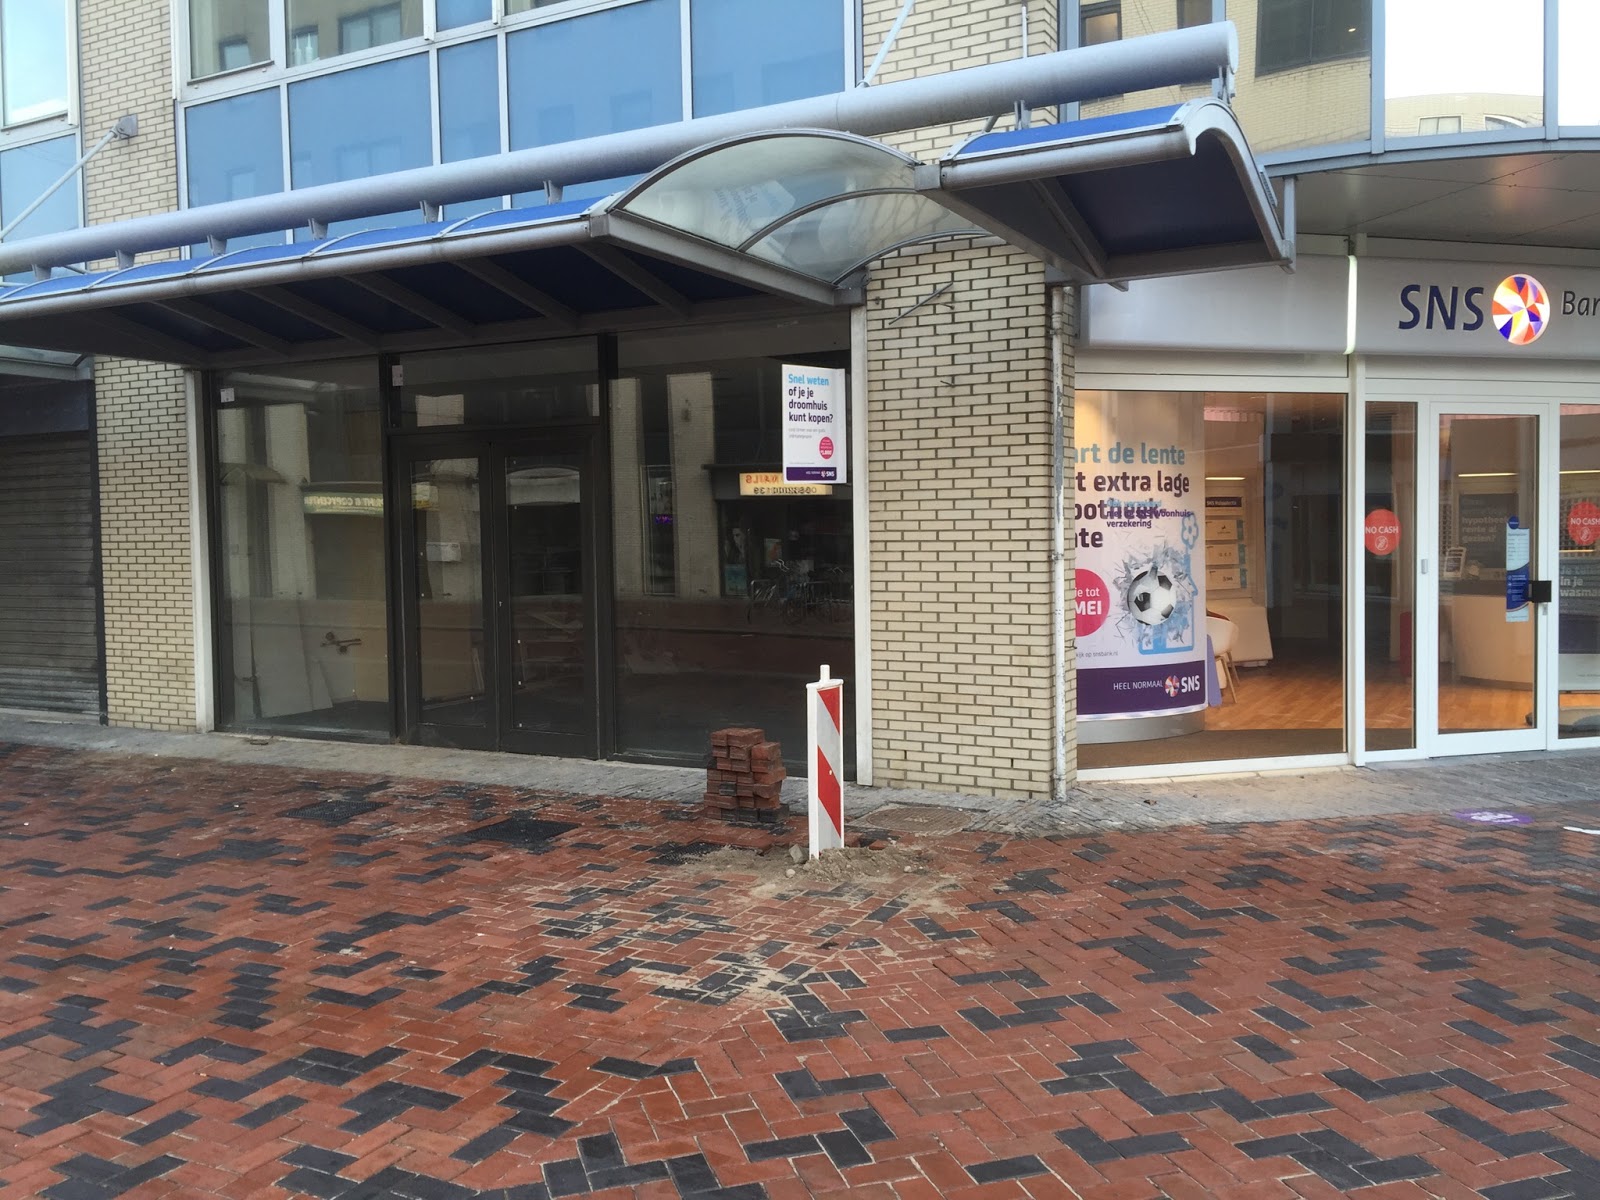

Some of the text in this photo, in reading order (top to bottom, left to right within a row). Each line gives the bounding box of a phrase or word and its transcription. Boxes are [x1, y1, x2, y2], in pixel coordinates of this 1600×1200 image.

[1398, 284, 1484, 331] SNS
[788, 373, 829, 386] Snel weten
[788, 386, 814, 400] of je je
[788, 399, 828, 411] droomhuis
[788, 411, 834, 425] kunt kopen?
[1075, 442, 1186, 466] rt de lente
[1093, 471, 1152, 492] extra
[1157, 470, 1190, 498] lage
[1106, 520, 1152, 529] verzekering
[1570, 517, 1600, 525] NO CASH
[1365, 525, 1399, 534] NO CASH
[1560, 576, 1571, 586] in
[1086, 587, 1100, 597] tot
[1075, 600, 1102, 616] MEI
[1113, 674, 1201, 693] HEEL NORMAAL SNS
